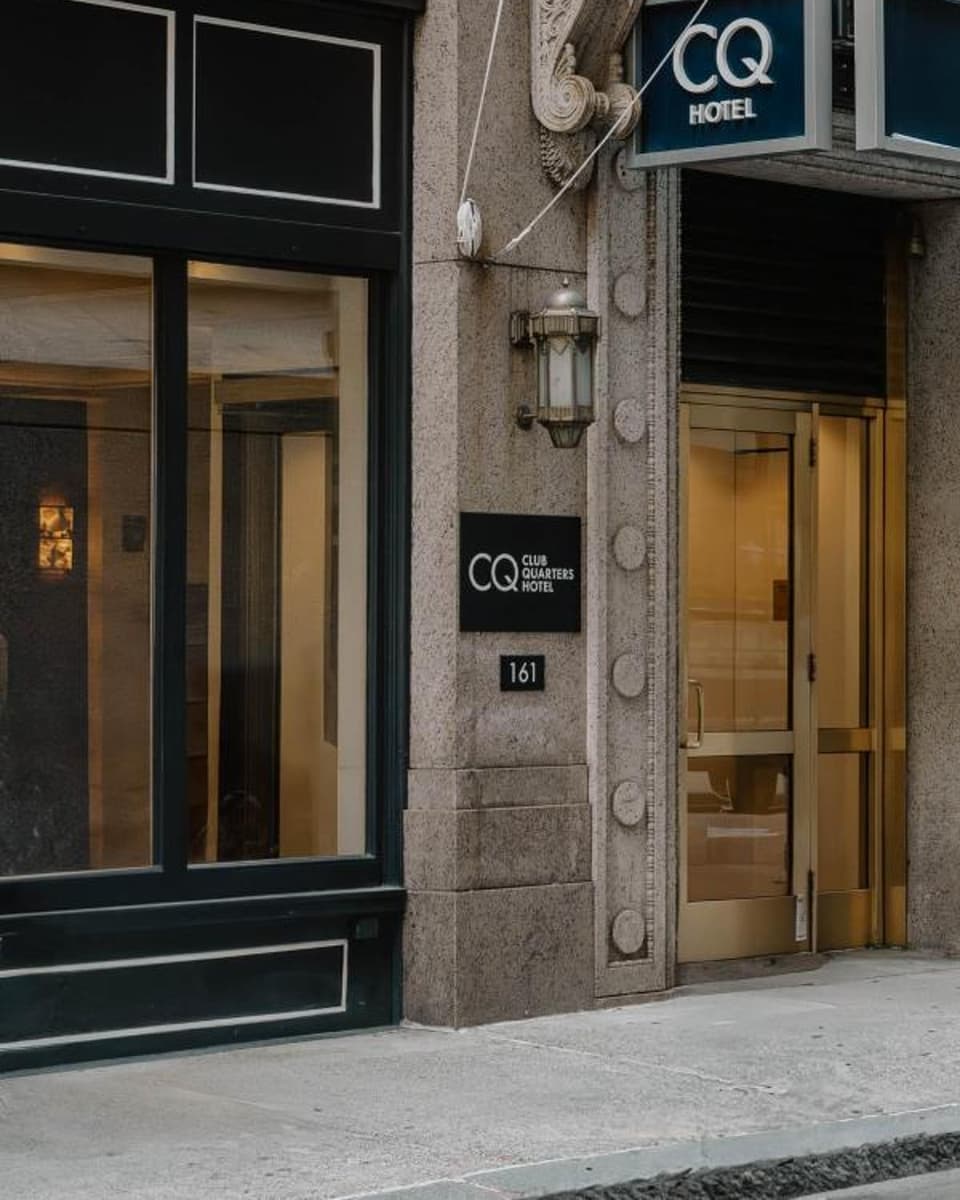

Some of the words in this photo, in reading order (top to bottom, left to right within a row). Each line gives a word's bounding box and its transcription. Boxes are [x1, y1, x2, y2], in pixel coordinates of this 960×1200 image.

[671, 16, 775, 94] CQ
[688, 97, 757, 126] HOTEL
[468, 552, 519, 592] CQ
[522, 555, 548, 566] CLUB
[522, 569, 574, 580] QUARTERS
[522, 581, 554, 593] HOTEL
[509, 661, 536, 684] 161
